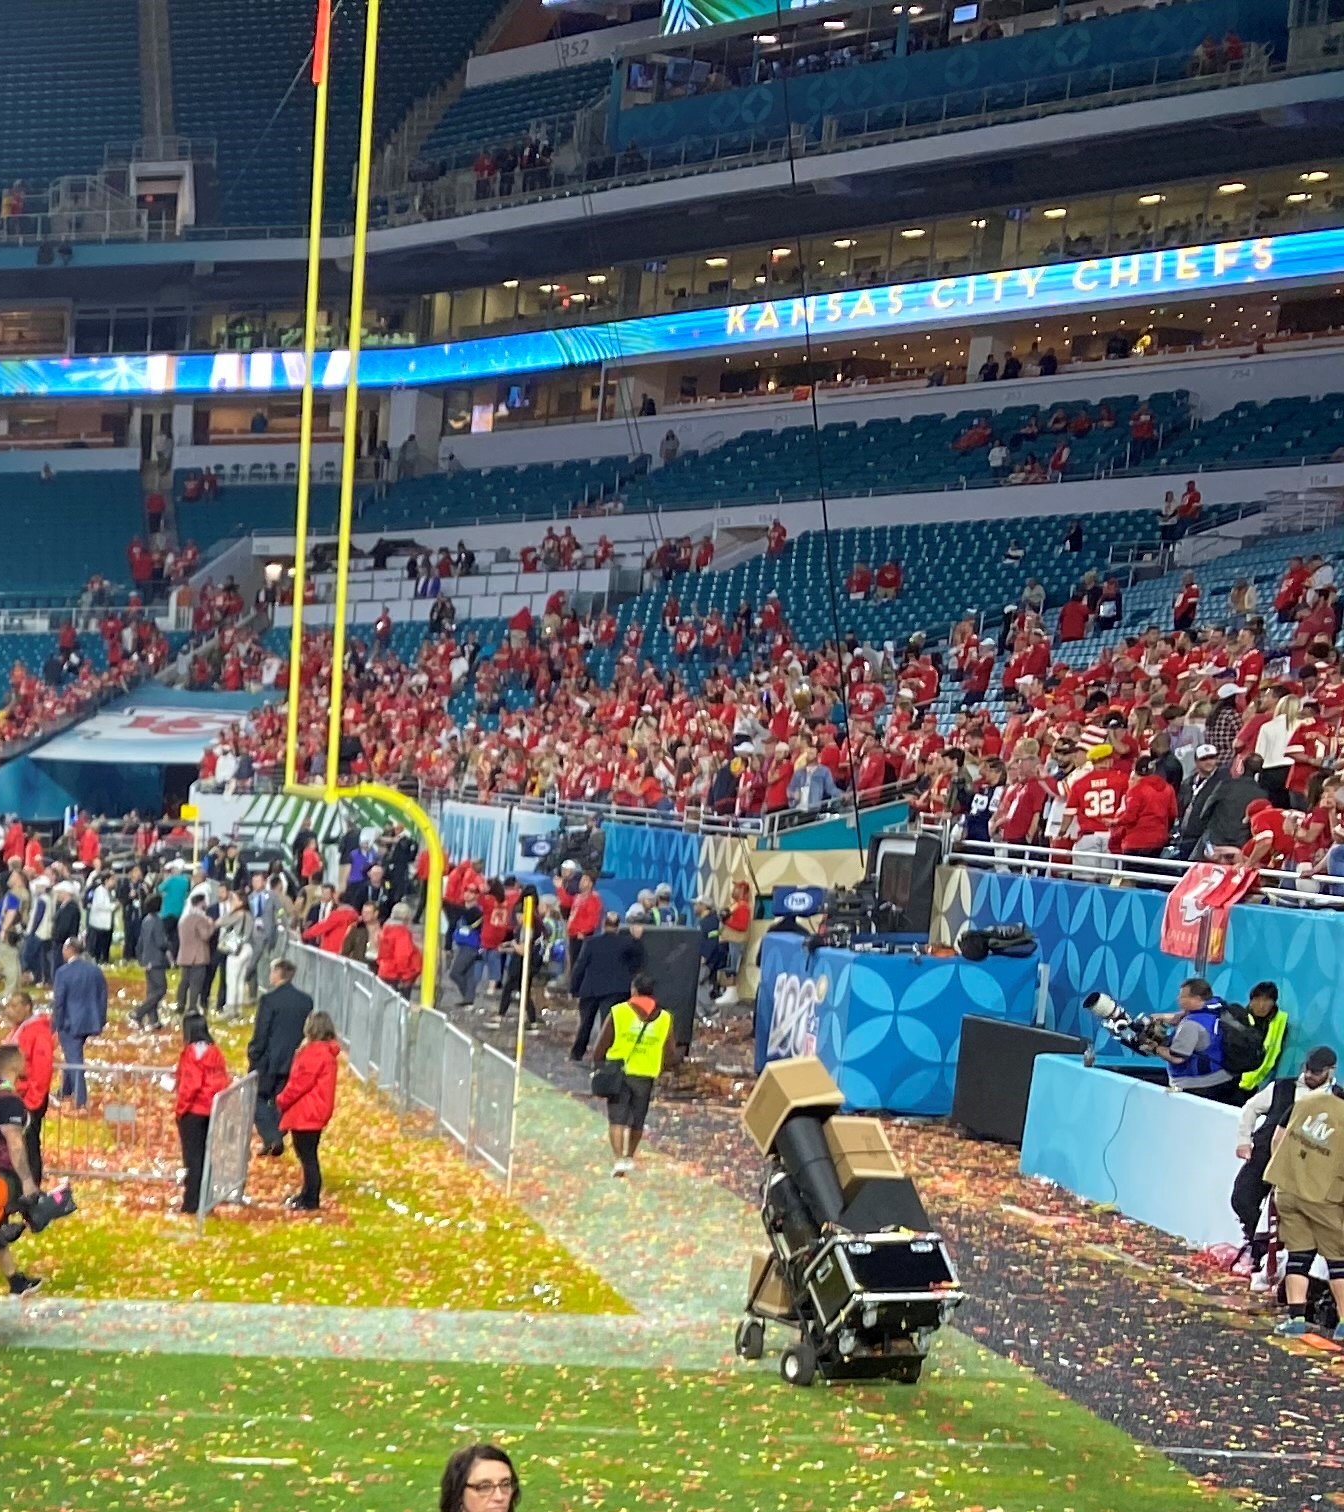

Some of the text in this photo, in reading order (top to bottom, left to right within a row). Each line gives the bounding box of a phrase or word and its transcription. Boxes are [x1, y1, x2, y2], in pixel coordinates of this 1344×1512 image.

[725, 237, 1274, 334] KANSAS CITY CHIEFS
[1084, 788, 1116, 818] 32
